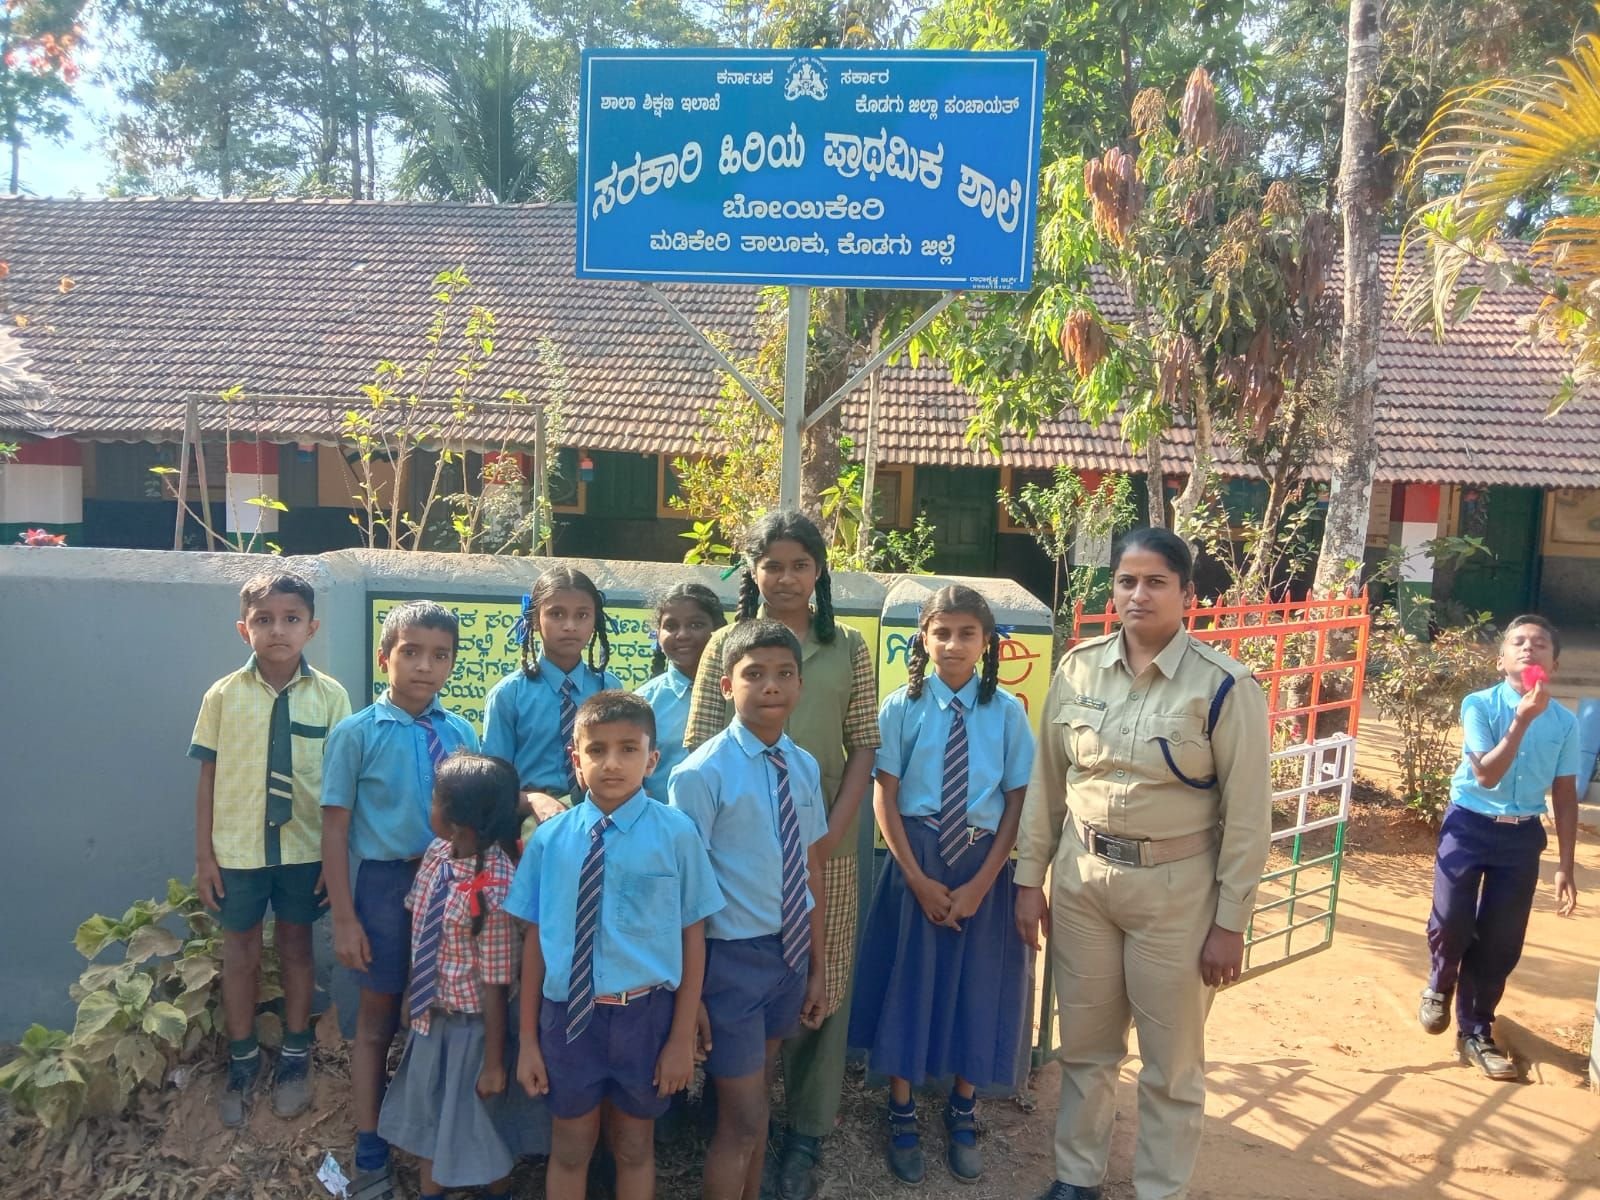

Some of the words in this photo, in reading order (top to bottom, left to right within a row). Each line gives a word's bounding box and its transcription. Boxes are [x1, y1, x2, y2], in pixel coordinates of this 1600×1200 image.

[717, 70, 773, 84] ಕರ್ನಾಟಕ
[841, 70, 889, 83] ಸರ್ಕಾರ
[601, 97, 635, 109] ಶಾಲಾ
[643, 94, 673, 117] ಶಿಕ್ಷಣ
[681, 94, 720, 112] ಇಲಾಖೆ
[856, 95, 903, 112] ಕೊಡಗು
[909, 100, 938, 119] ಜಿಲ್ಲಾ
[945, 96, 1019, 113] ಪಂಚಾಯತ್
[593, 142, 702, 219] ಸರಕಾರಿ
[719, 123, 804, 174] ಹಿರಿಯ
[824, 128, 943, 188] ಪ್ರಾಥಮಿಕ
[958, 165, 1021, 232] ಶಾಲೆ
[724, 194, 884, 219] ಬೋಯಿಕೇರಿ
[651, 230, 730, 251] ಮಡಿಕೇರಿ
[740, 231, 829, 256] ತಾಲೂಕು,
[838, 233, 911, 254] ಕೊಡಗು
[922, 235, 955, 264] ಜಿಲ್ಲೆ
